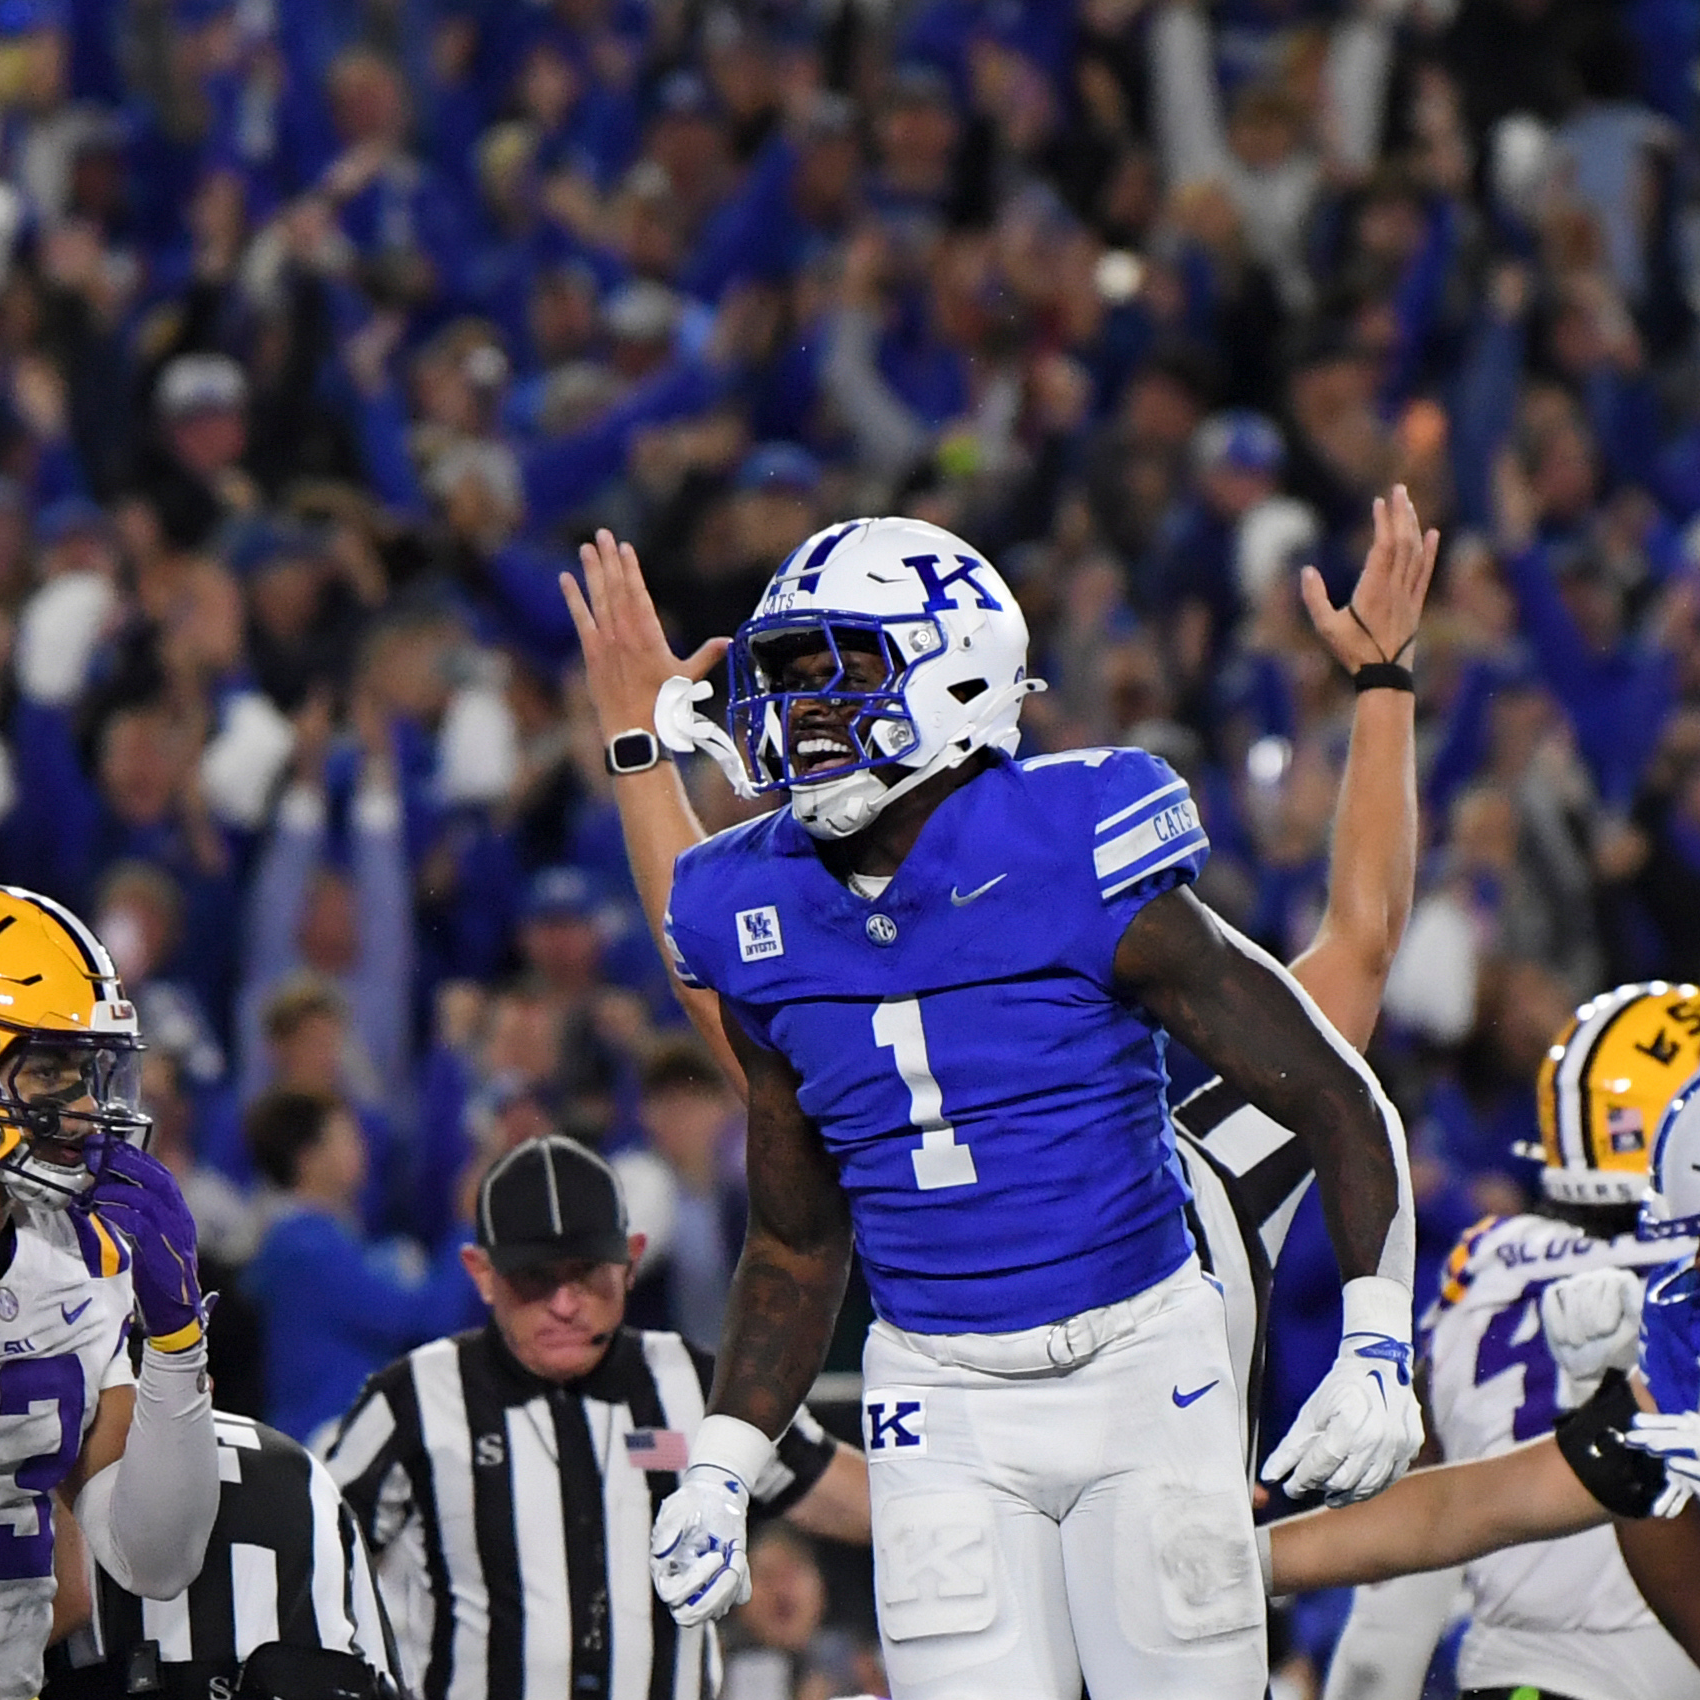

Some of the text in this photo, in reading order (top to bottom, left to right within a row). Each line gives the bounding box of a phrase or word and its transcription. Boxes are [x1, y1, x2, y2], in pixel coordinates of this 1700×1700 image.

[901, 555, 1003, 612] K
[763, 592, 796, 615] CATS
[1153, 803, 1193, 842] CATS
[743, 911, 774, 942] UK
[867, 911, 896, 941] SEC
[872, 995, 978, 1190] 1
[868, 1401, 922, 1450] K
[475, 1432, 505, 1468] S
